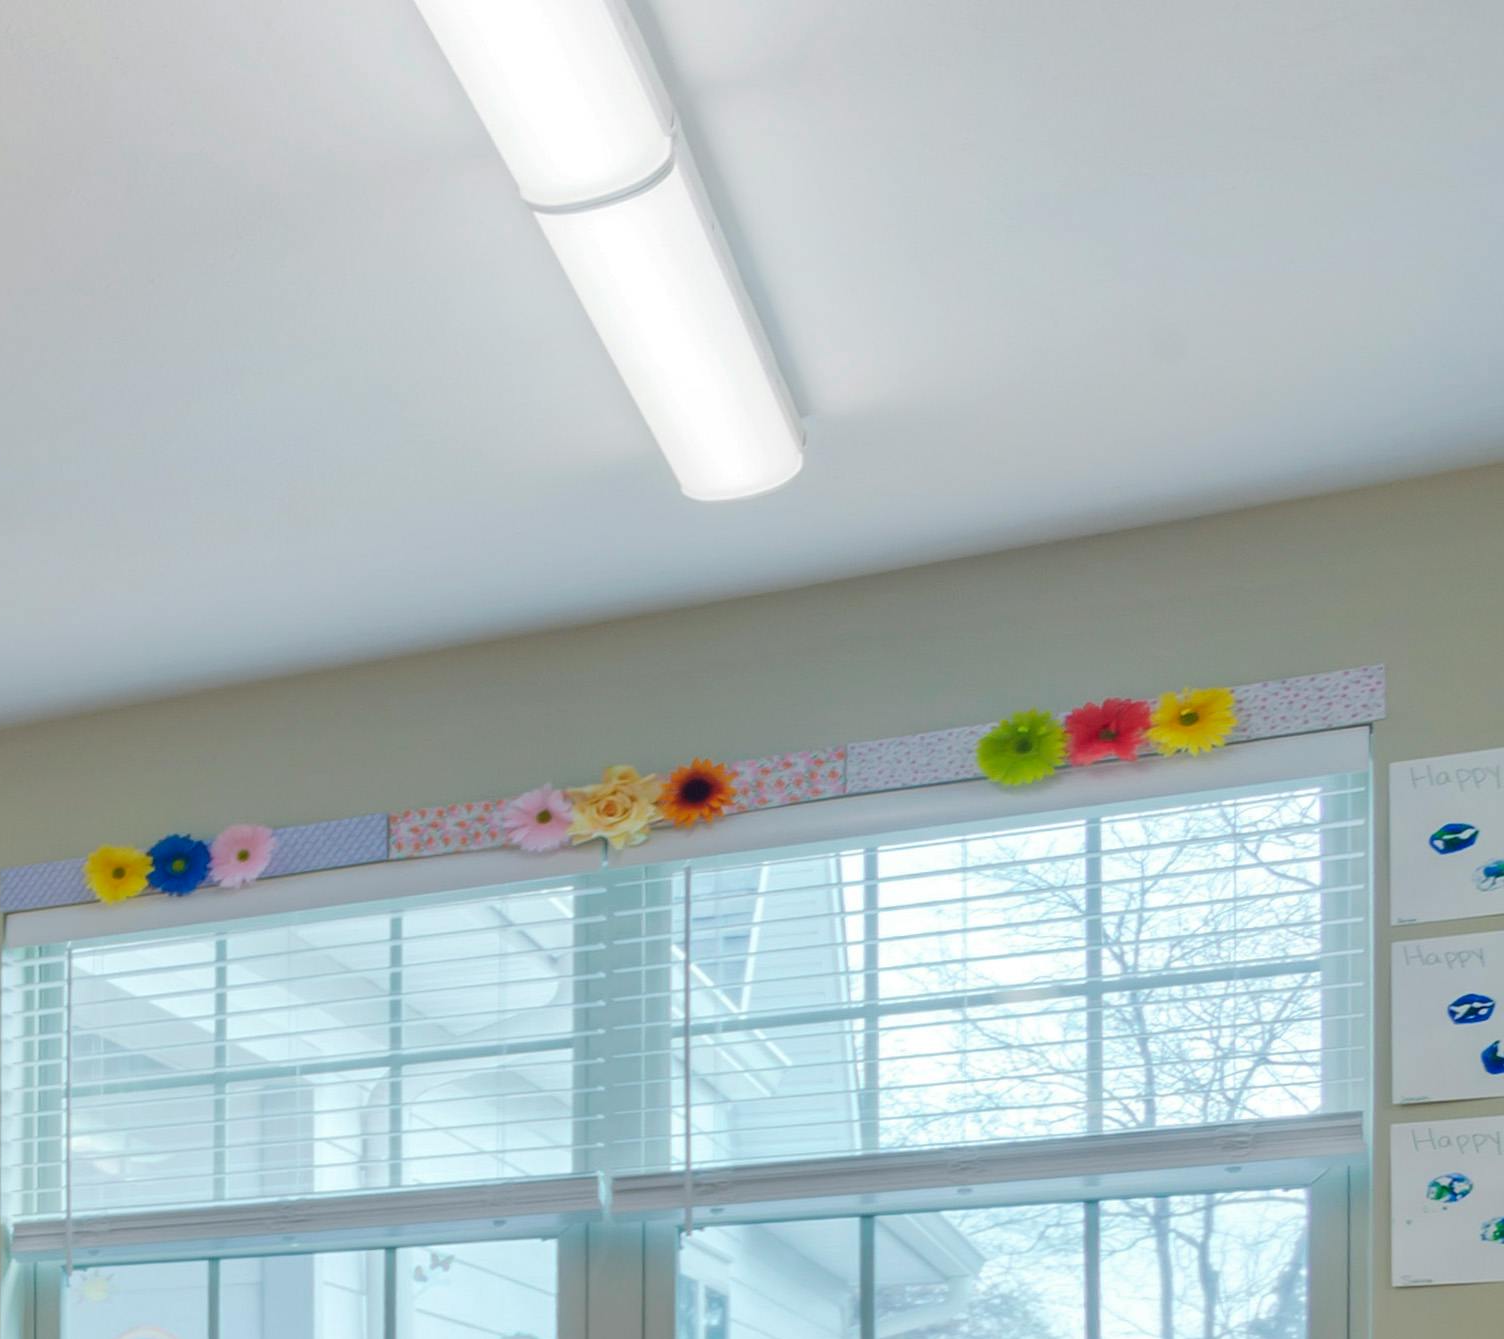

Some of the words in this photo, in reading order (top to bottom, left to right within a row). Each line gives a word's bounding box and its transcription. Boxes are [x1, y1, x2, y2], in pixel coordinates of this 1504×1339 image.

[1410, 764, 1503, 793] Happy
[1402, 944, 1487, 970] Happy
[1411, 1127, 1504, 1156] Happy
